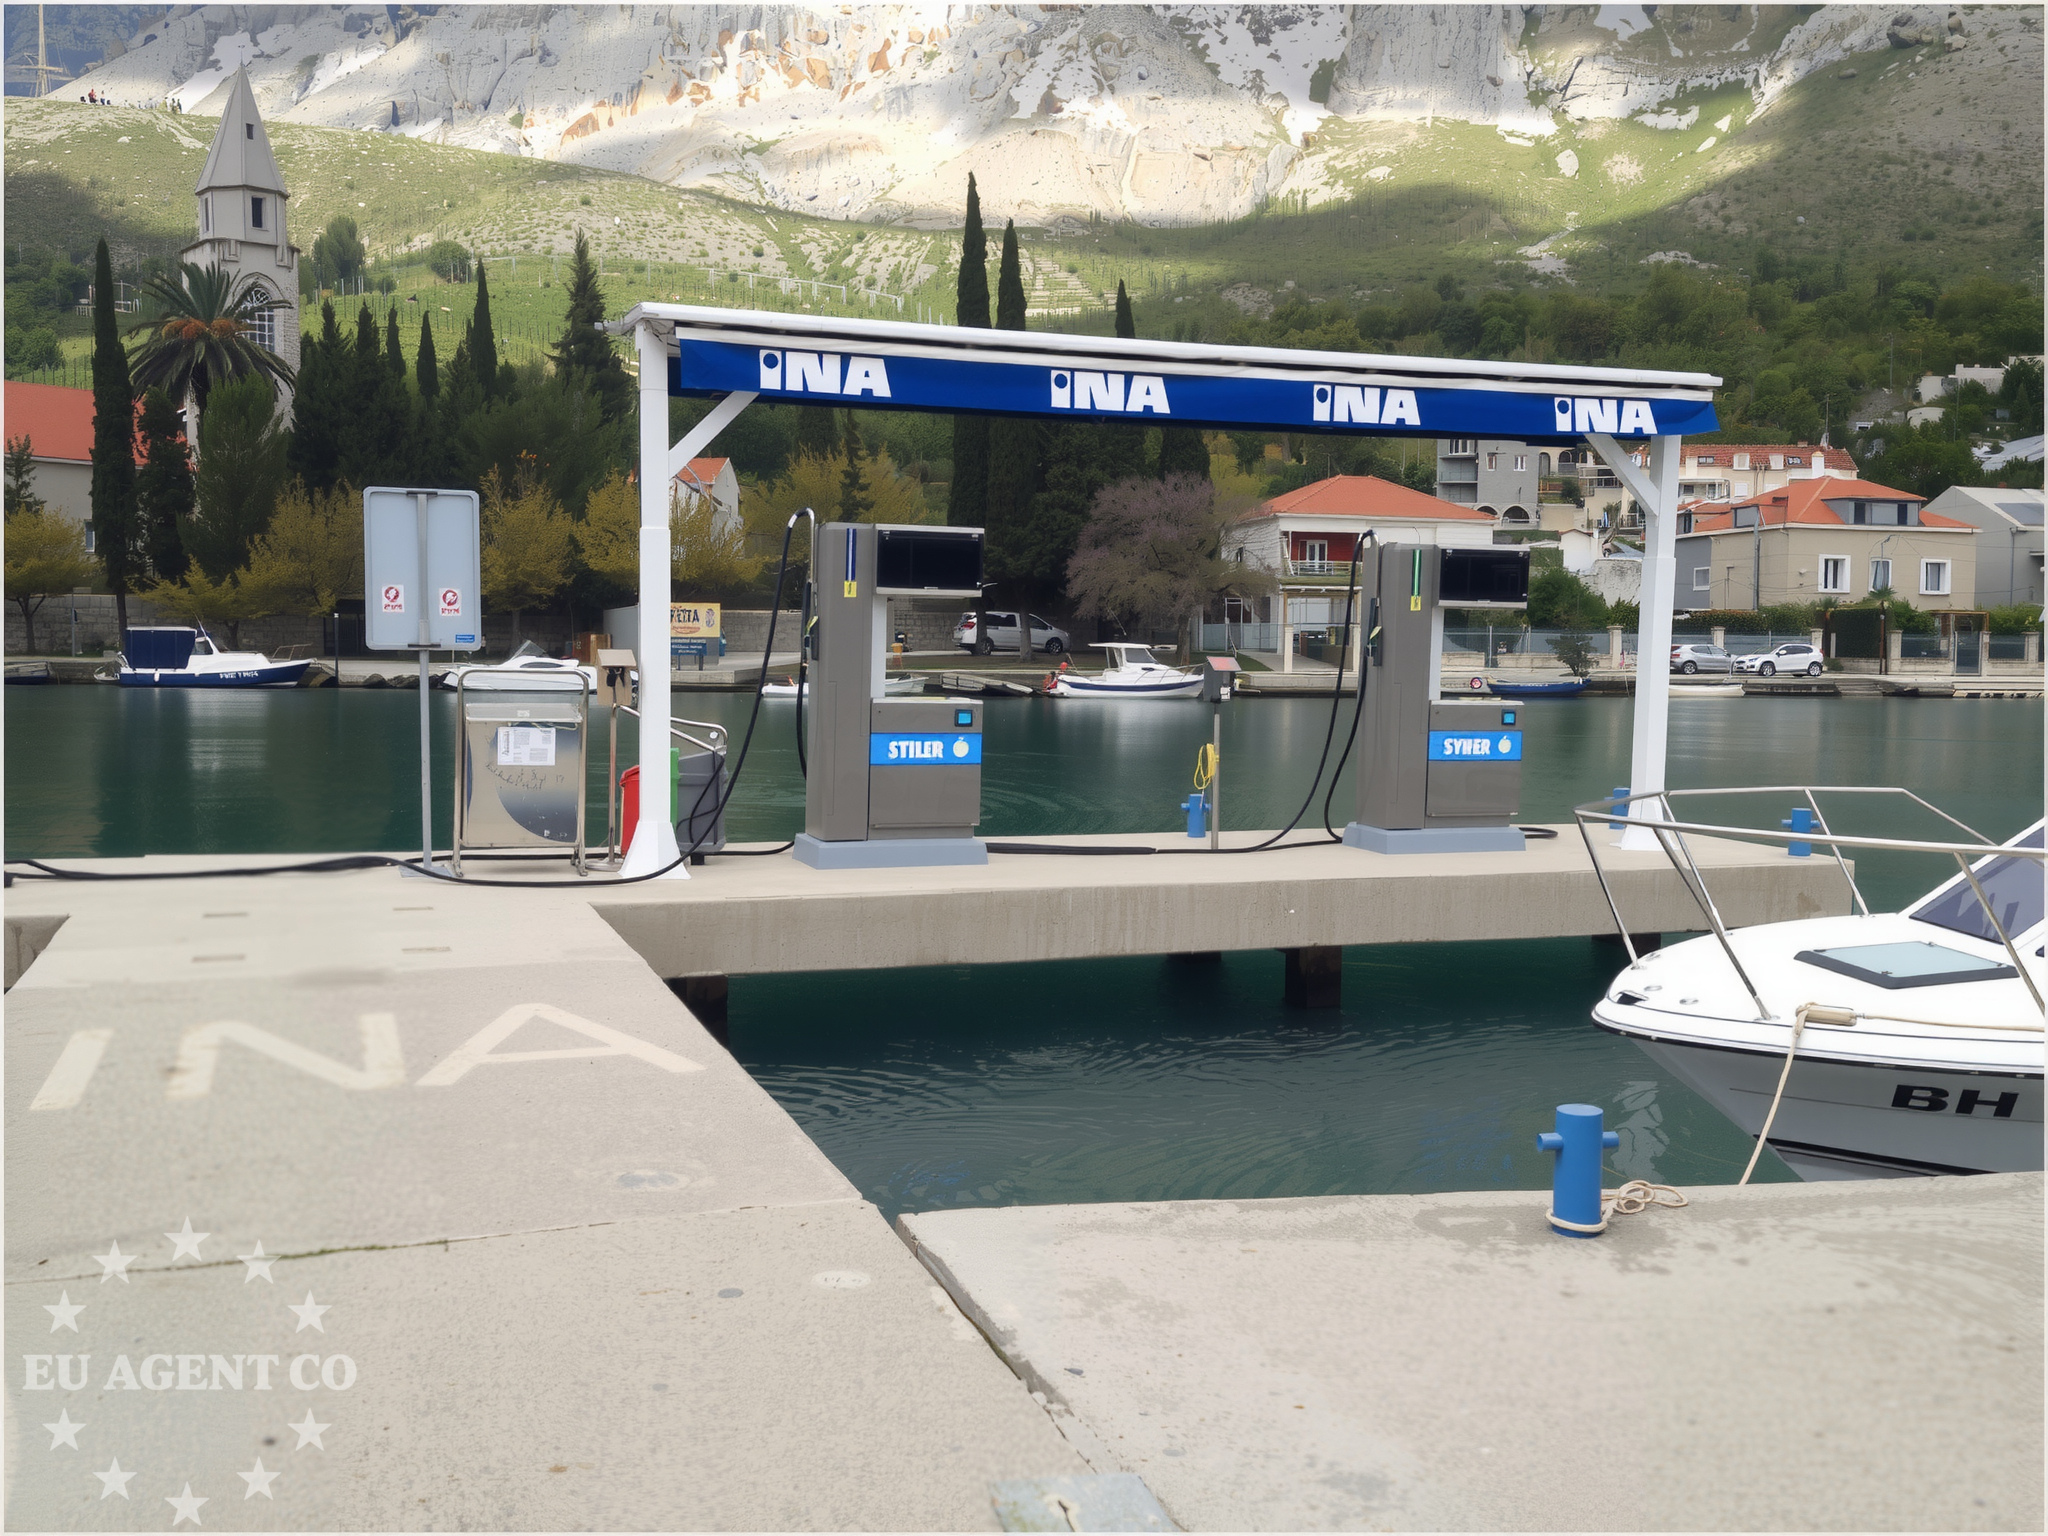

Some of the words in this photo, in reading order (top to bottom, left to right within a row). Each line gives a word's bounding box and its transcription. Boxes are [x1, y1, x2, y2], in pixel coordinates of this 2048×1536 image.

[888, 740, 944, 759] STILER
[28, 1003, 705, 1110] INA
[1891, 1084, 2019, 1118] BH
